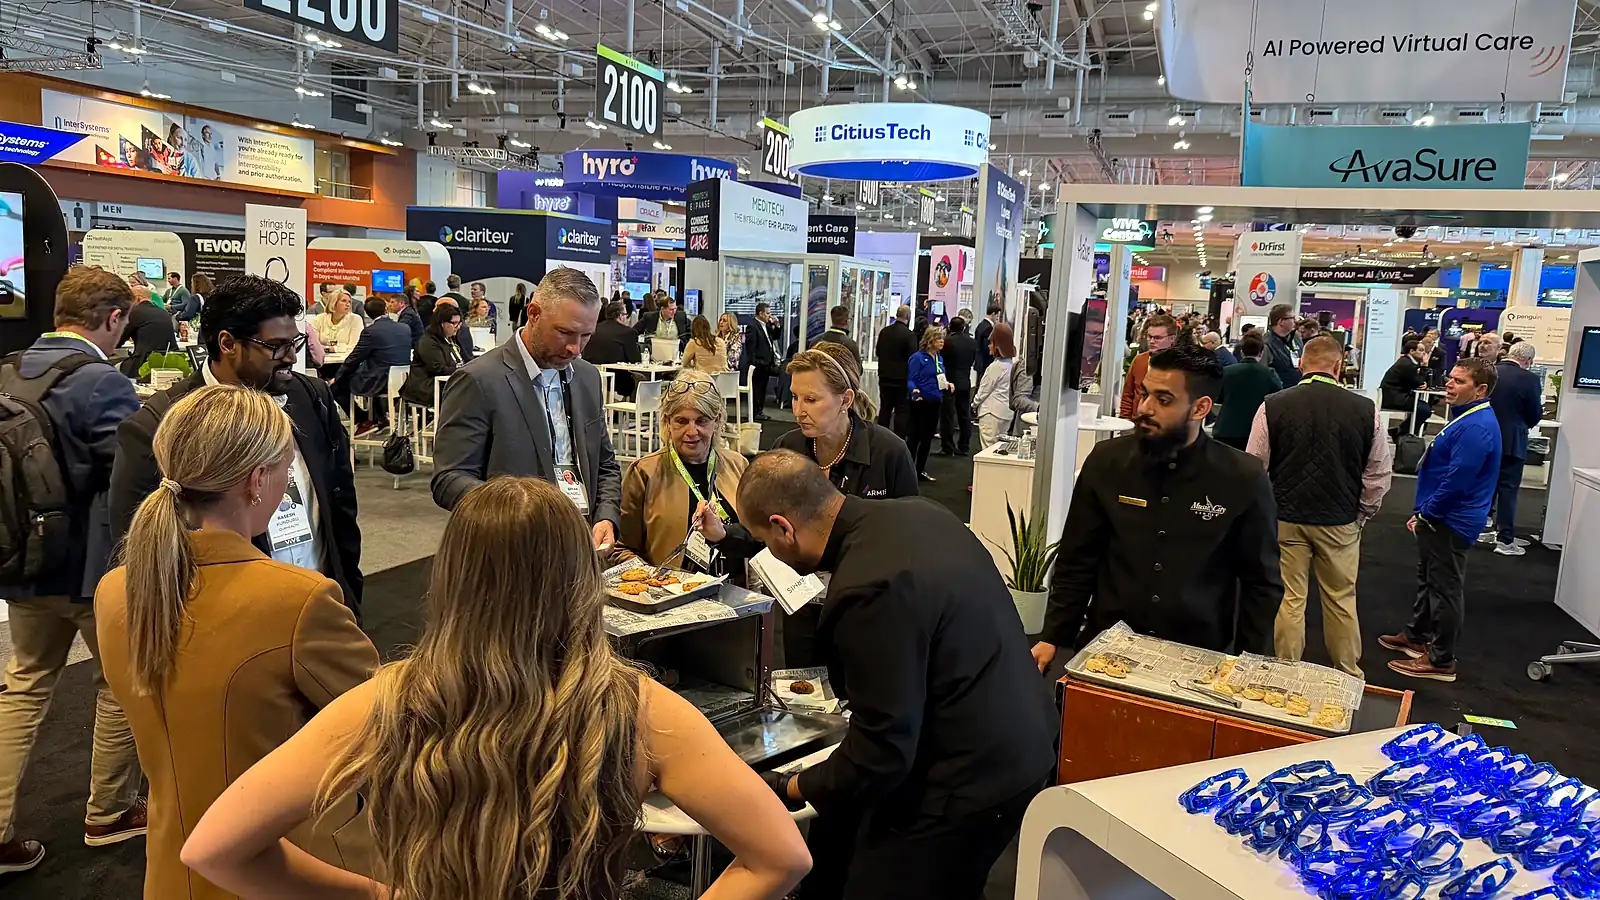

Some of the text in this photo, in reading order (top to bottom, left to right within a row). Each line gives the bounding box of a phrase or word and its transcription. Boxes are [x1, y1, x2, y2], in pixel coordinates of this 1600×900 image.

[1262, 32, 1534, 57] AI Powered Virtual Care
[603, 64, 657, 134] 2100
[63, 118, 110, 133] InterSystems
[831, 123, 931, 141] CitiusTech
[237, 135, 253, 144] With
[4, 146, 40, 157] technology
[257, 148, 278, 157] already
[278, 151, 294, 160] ready
[766, 130, 796, 180] 200
[238, 168, 250, 176] and
[582, 152, 636, 180] hyro
[1329, 148, 1497, 183] AvaSure
[102, 204, 122, 214] MEN
[533, 193, 570, 213] hyro
[752, 196, 785, 217] MEDITECH
[640, 207, 660, 218] ORACLE
[259, 219, 295, 230] strings for
[825, 223, 849, 233] Care
[259, 230, 295, 246] HOPE
[455, 226, 510, 244] claritev
[567, 228, 600, 247] claritev
[1258, 242, 1286, 251] DrFirst
[1212, 504, 1227, 515] City
[786, 578, 806, 594] ARMIS
